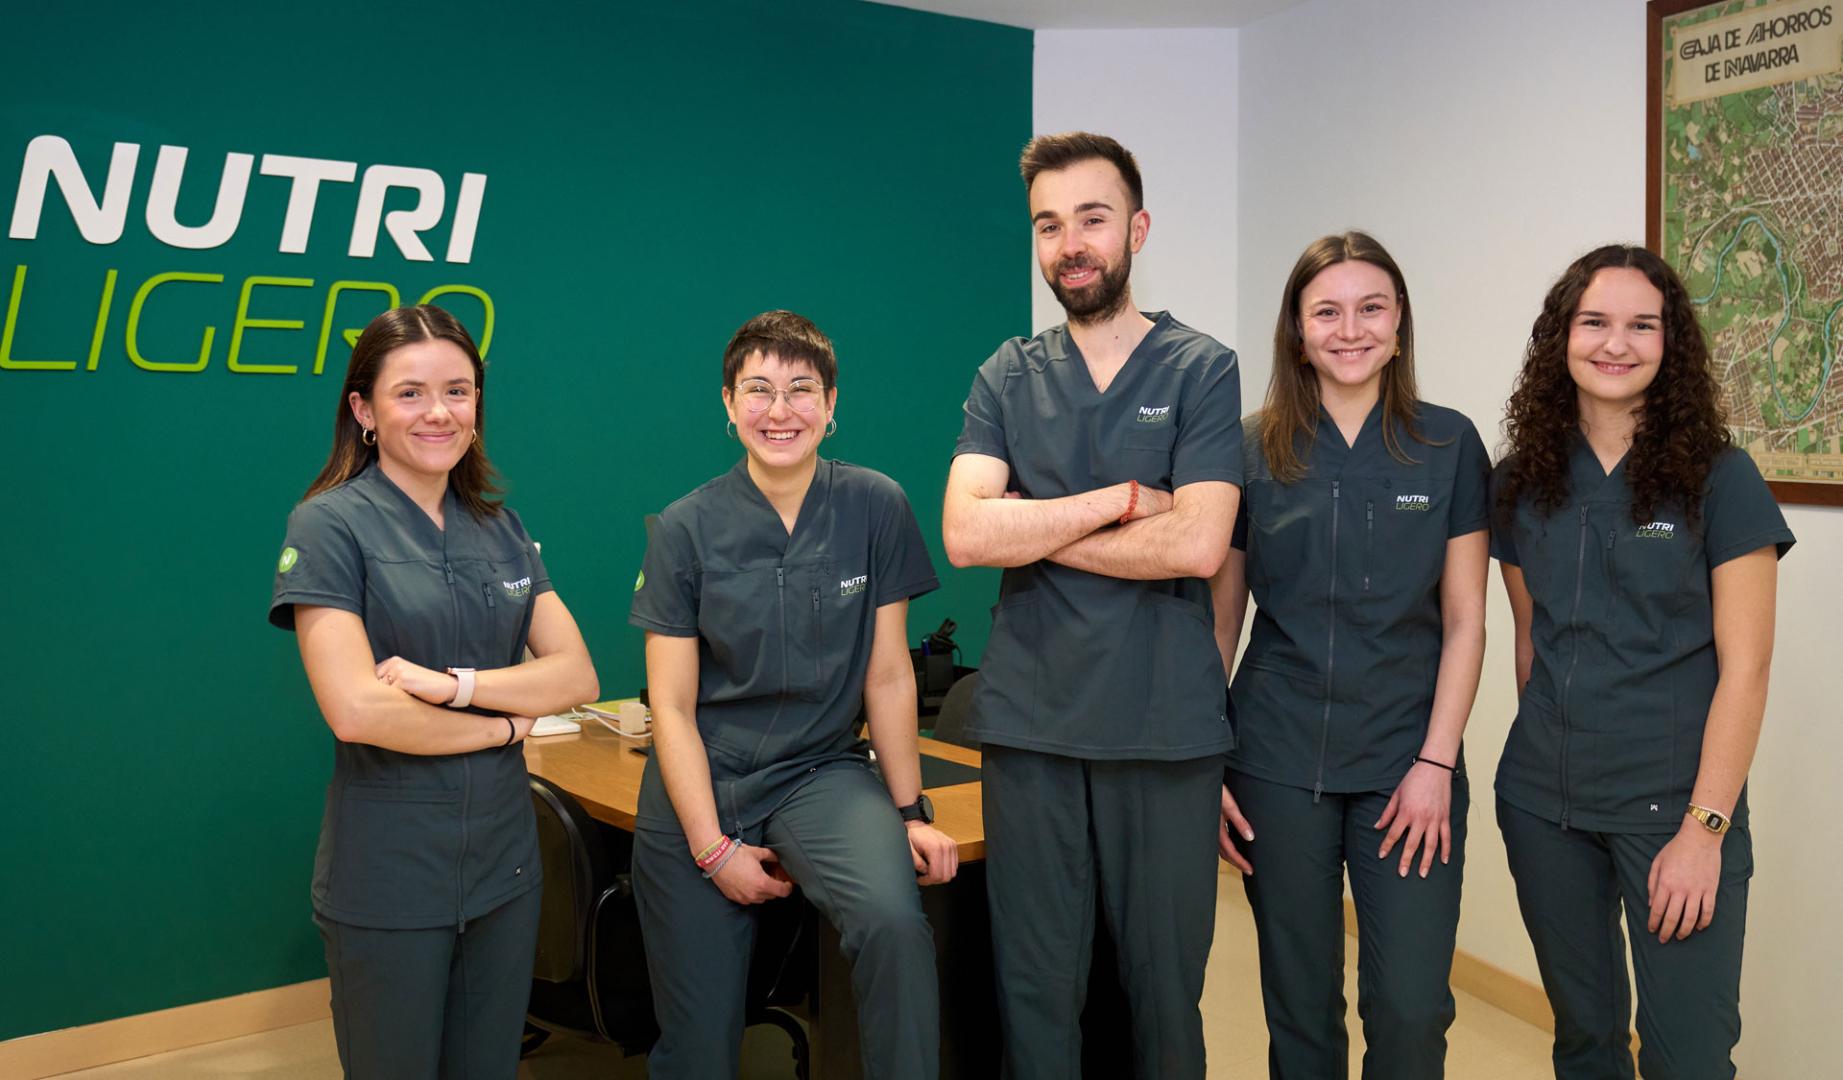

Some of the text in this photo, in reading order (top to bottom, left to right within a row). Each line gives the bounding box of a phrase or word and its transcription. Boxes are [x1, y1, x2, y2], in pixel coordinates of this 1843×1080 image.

[1680, 5, 1832, 60] CAJA DE AHORROS
[1705, 44, 1799, 83] DE NAVARRA
[9, 135, 488, 263] NUTRI
[1396, 495, 1429, 503] NUTRI
[1395, 503, 1430, 511] LIGERO
[1636, 530, 1674, 539] LIGERO
[840, 575, 868, 588] NUTR
[841, 584, 865, 596] LIGER
